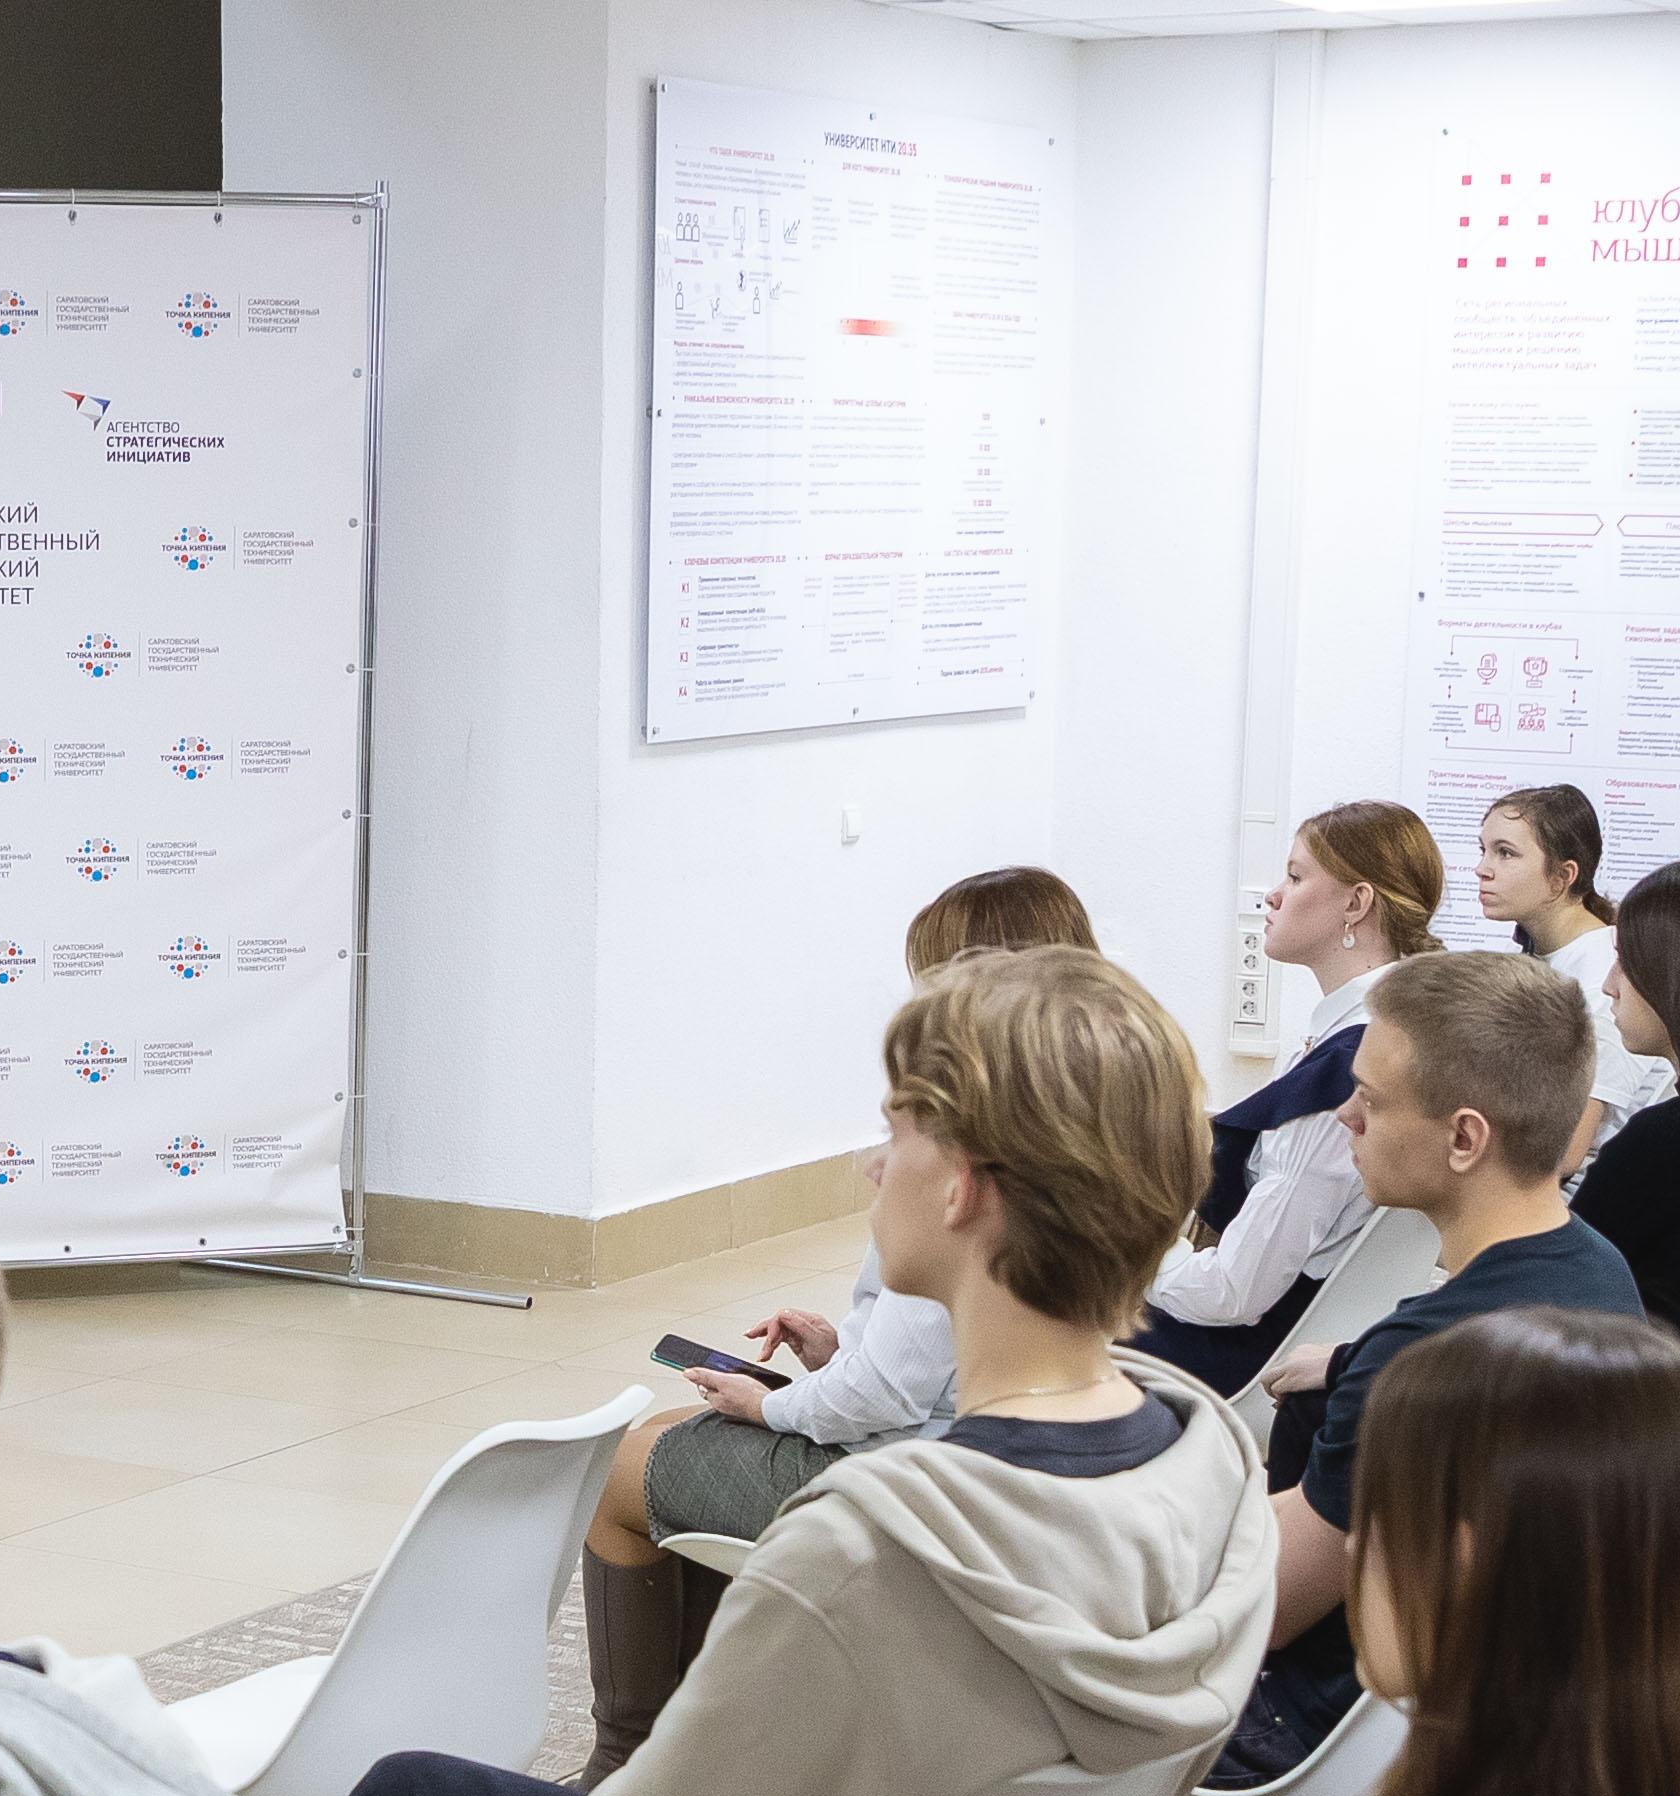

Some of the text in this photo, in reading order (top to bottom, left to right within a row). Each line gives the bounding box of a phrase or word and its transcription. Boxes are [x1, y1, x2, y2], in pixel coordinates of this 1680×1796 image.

[824, 131, 917, 156] УНИВЕРСИТЕТ НТИ 20.35
[106, 420, 181, 433] АГЕНТСТВО
[106, 434, 225, 449] СТРАТЕГИЧЕСКИХ
[106, 449, 191, 464] ИНИЦИАТИВ
[1625, 625, 1660, 634] Решение
[1605, 778, 1677, 791] Образовательная
